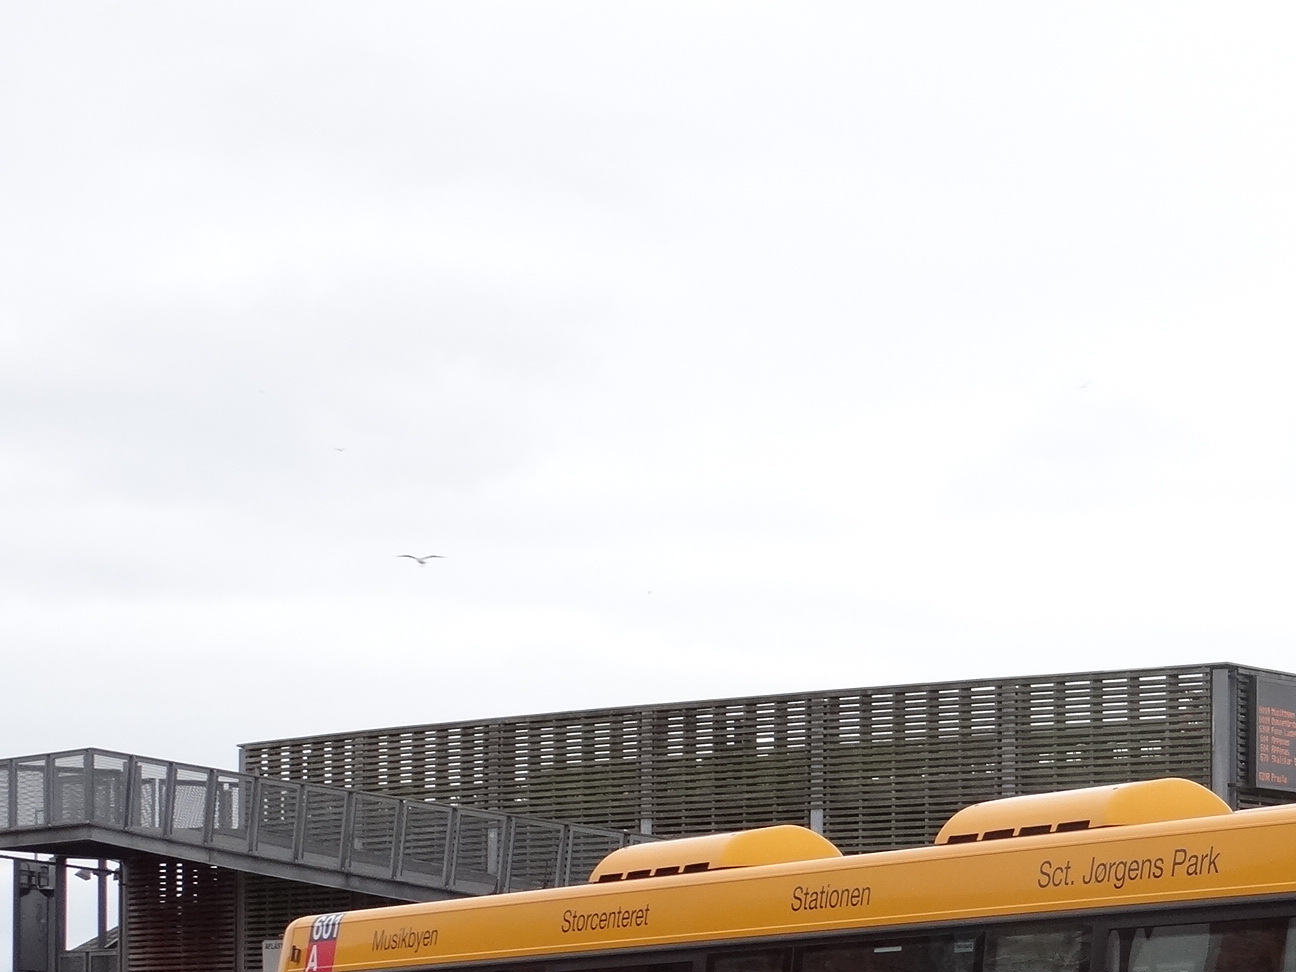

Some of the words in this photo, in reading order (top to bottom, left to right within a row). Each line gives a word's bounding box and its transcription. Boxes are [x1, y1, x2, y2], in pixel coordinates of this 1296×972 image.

[1037, 859, 1075, 889] Sct.
[1082, 854, 1164, 890] Jørgens
[1172, 846, 1219, 877] Park
[790, 884, 872, 912] Stationen
[312, 914, 344, 940] 601
[561, 904, 651, 933] Storcenteret
[371, 927, 439, 953] Musikbyen
[305, 944, 318, 972] A
